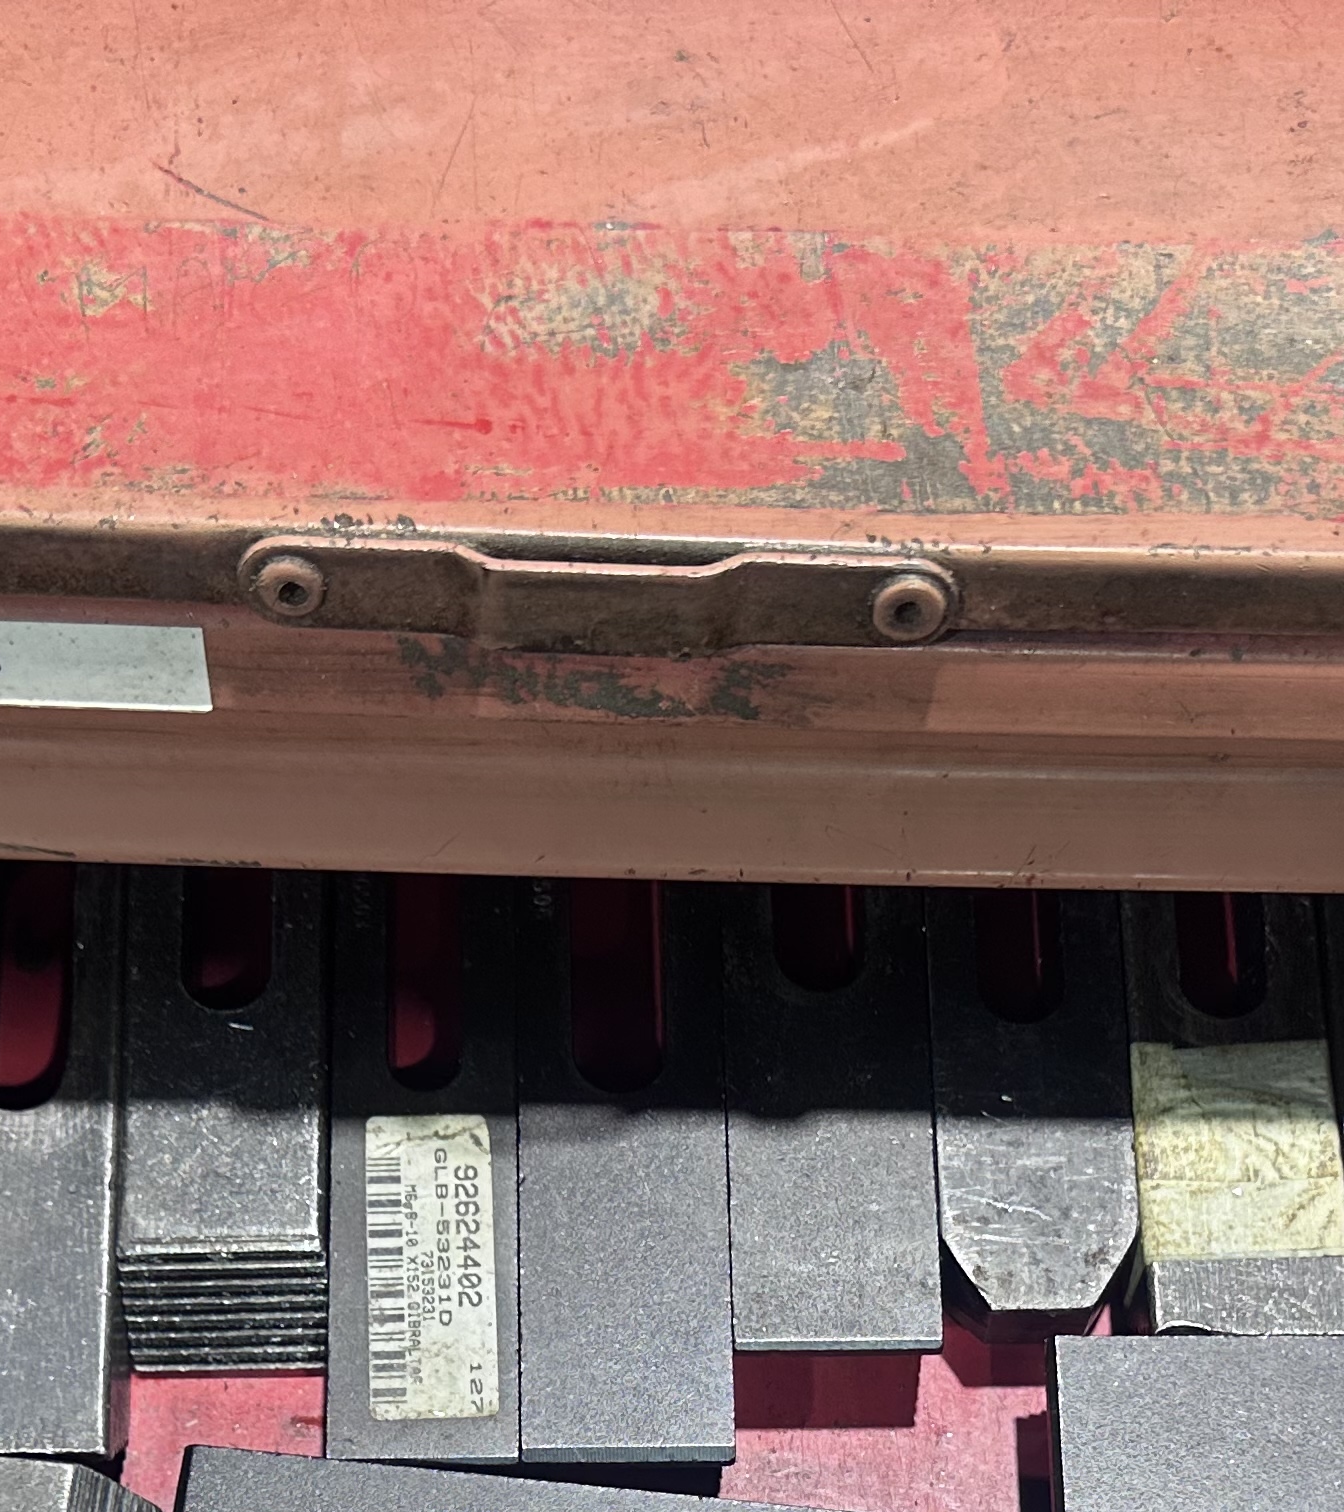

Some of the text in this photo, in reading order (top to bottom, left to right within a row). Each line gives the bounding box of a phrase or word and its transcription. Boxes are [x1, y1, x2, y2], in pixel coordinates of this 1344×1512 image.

[421, 1250, 436, 1322] 73153231
[433, 1148, 452, 1327] GLB-53231D
[454, 1164, 483, 1308] 92624402
[469, 1362, 484, 1415] 127
